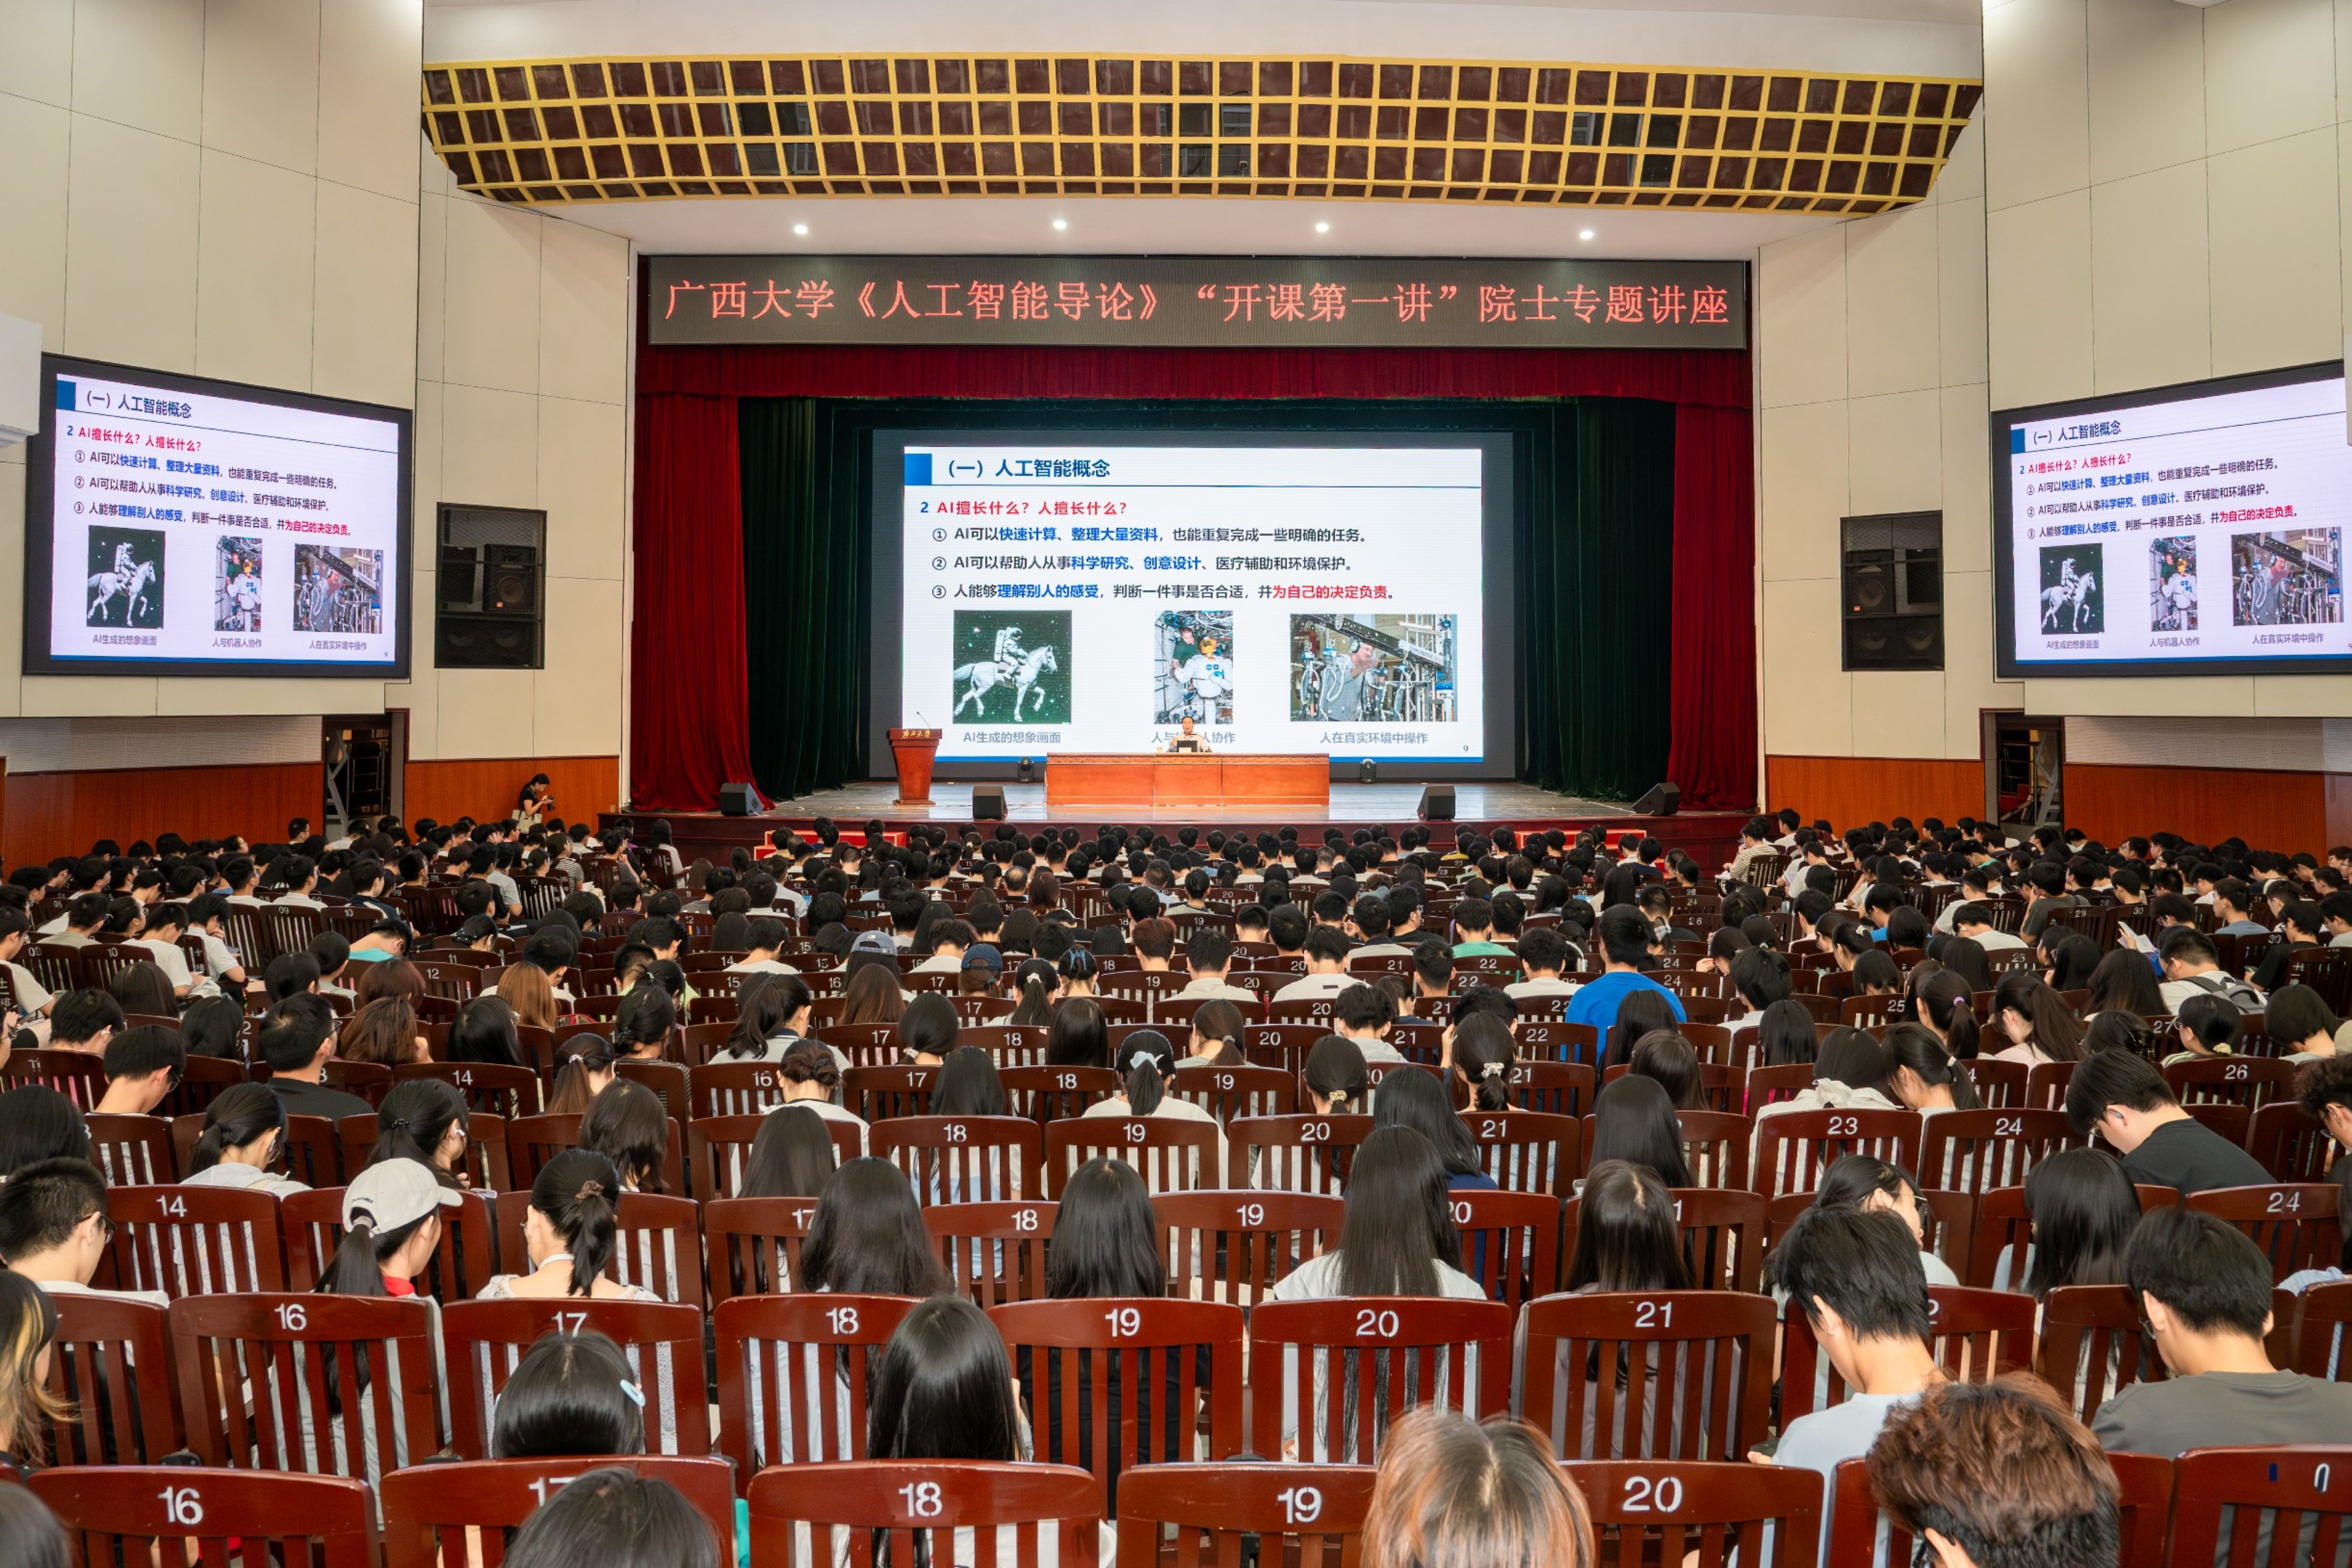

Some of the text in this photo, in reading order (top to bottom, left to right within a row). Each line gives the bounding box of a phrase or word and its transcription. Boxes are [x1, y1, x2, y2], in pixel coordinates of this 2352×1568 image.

[920, 502, 929, 513] 2
[1152, 731, 1236, 745] 人与人协作
[1463, 745, 1468, 753] 9
[2268, 935, 2282, 943] 30
[108, 947, 118, 957] 10
[800, 942, 810, 950] 15
[1233, 947, 1246, 956] 20
[448, 954, 457, 964] 11
[721, 956, 734, 966] 14
[1103, 961, 1115, 970] 18
[1388, 960, 1402, 970] 21
[1480, 959, 1497, 968] 22
[1663, 958, 1680, 968] 24
[1007, 961, 1021, 971] 17
[1291, 961, 1306, 971] 20
[427, 969, 439, 979] 12
[1664, 975, 1681, 986] 24
[727, 977, 740, 988] 15
[829, 978, 841, 988] 16
[930, 976, 944, 987] 17
[1146, 976, 1160, 987] 19
[1245, 978, 1260, 988] 20
[1459, 977, 1478, 987] 22
[965, 1001, 982, 1013] 17
[1312, 1003, 1331, 1015] 20
[1432, 1002, 1451, 1013] 21
[1888, 1000, 1905, 1012] 25
[872, 1030, 891, 1044] 17
[1003, 1033, 1022, 1046] 18
[1260, 1031, 1280, 1045] 20
[1395, 1031, 1416, 1044] 21
[1526, 1029, 1548, 1041] 22
[453, 1070, 473, 1085] 14
[753, 1071, 773, 1087] 16
[2225, 1065, 2247, 1080] 26
[907, 1073, 927, 1087] 17
[1057, 1074, 1077, 1089] 18
[1213, 1074, 1234, 1089] 19
[1302, 1123, 1330, 1141] 20
[1481, 1120, 1506, 1138] 21
[1828, 1116, 1858, 1135] 23
[1995, 1118, 2022, 1136] 24
[944, 1124, 967, 1143] 18
[1123, 1124, 1146, 1143] 19
[156, 1195, 187, 1217] 14
[2268, 1192, 2300, 1212] 24
[1012, 1209, 1038, 1230] 18
[1237, 1204, 1264, 1226] 19
[274, 1304, 306, 1330] 16
[826, 1307, 859, 1334] 18
[1636, 1302, 1672, 1328] 21
[552, 1311, 587, 1338] 17
[1105, 1308, 1140, 1337] 19
[1356, 1309, 1399, 1337] 20
[898, 1483, 942, 1516] 18
[1622, 1476, 1682, 1512] 20
[158, 1486, 203, 1524] 16
[1278, 1488, 1321, 1524] 19
